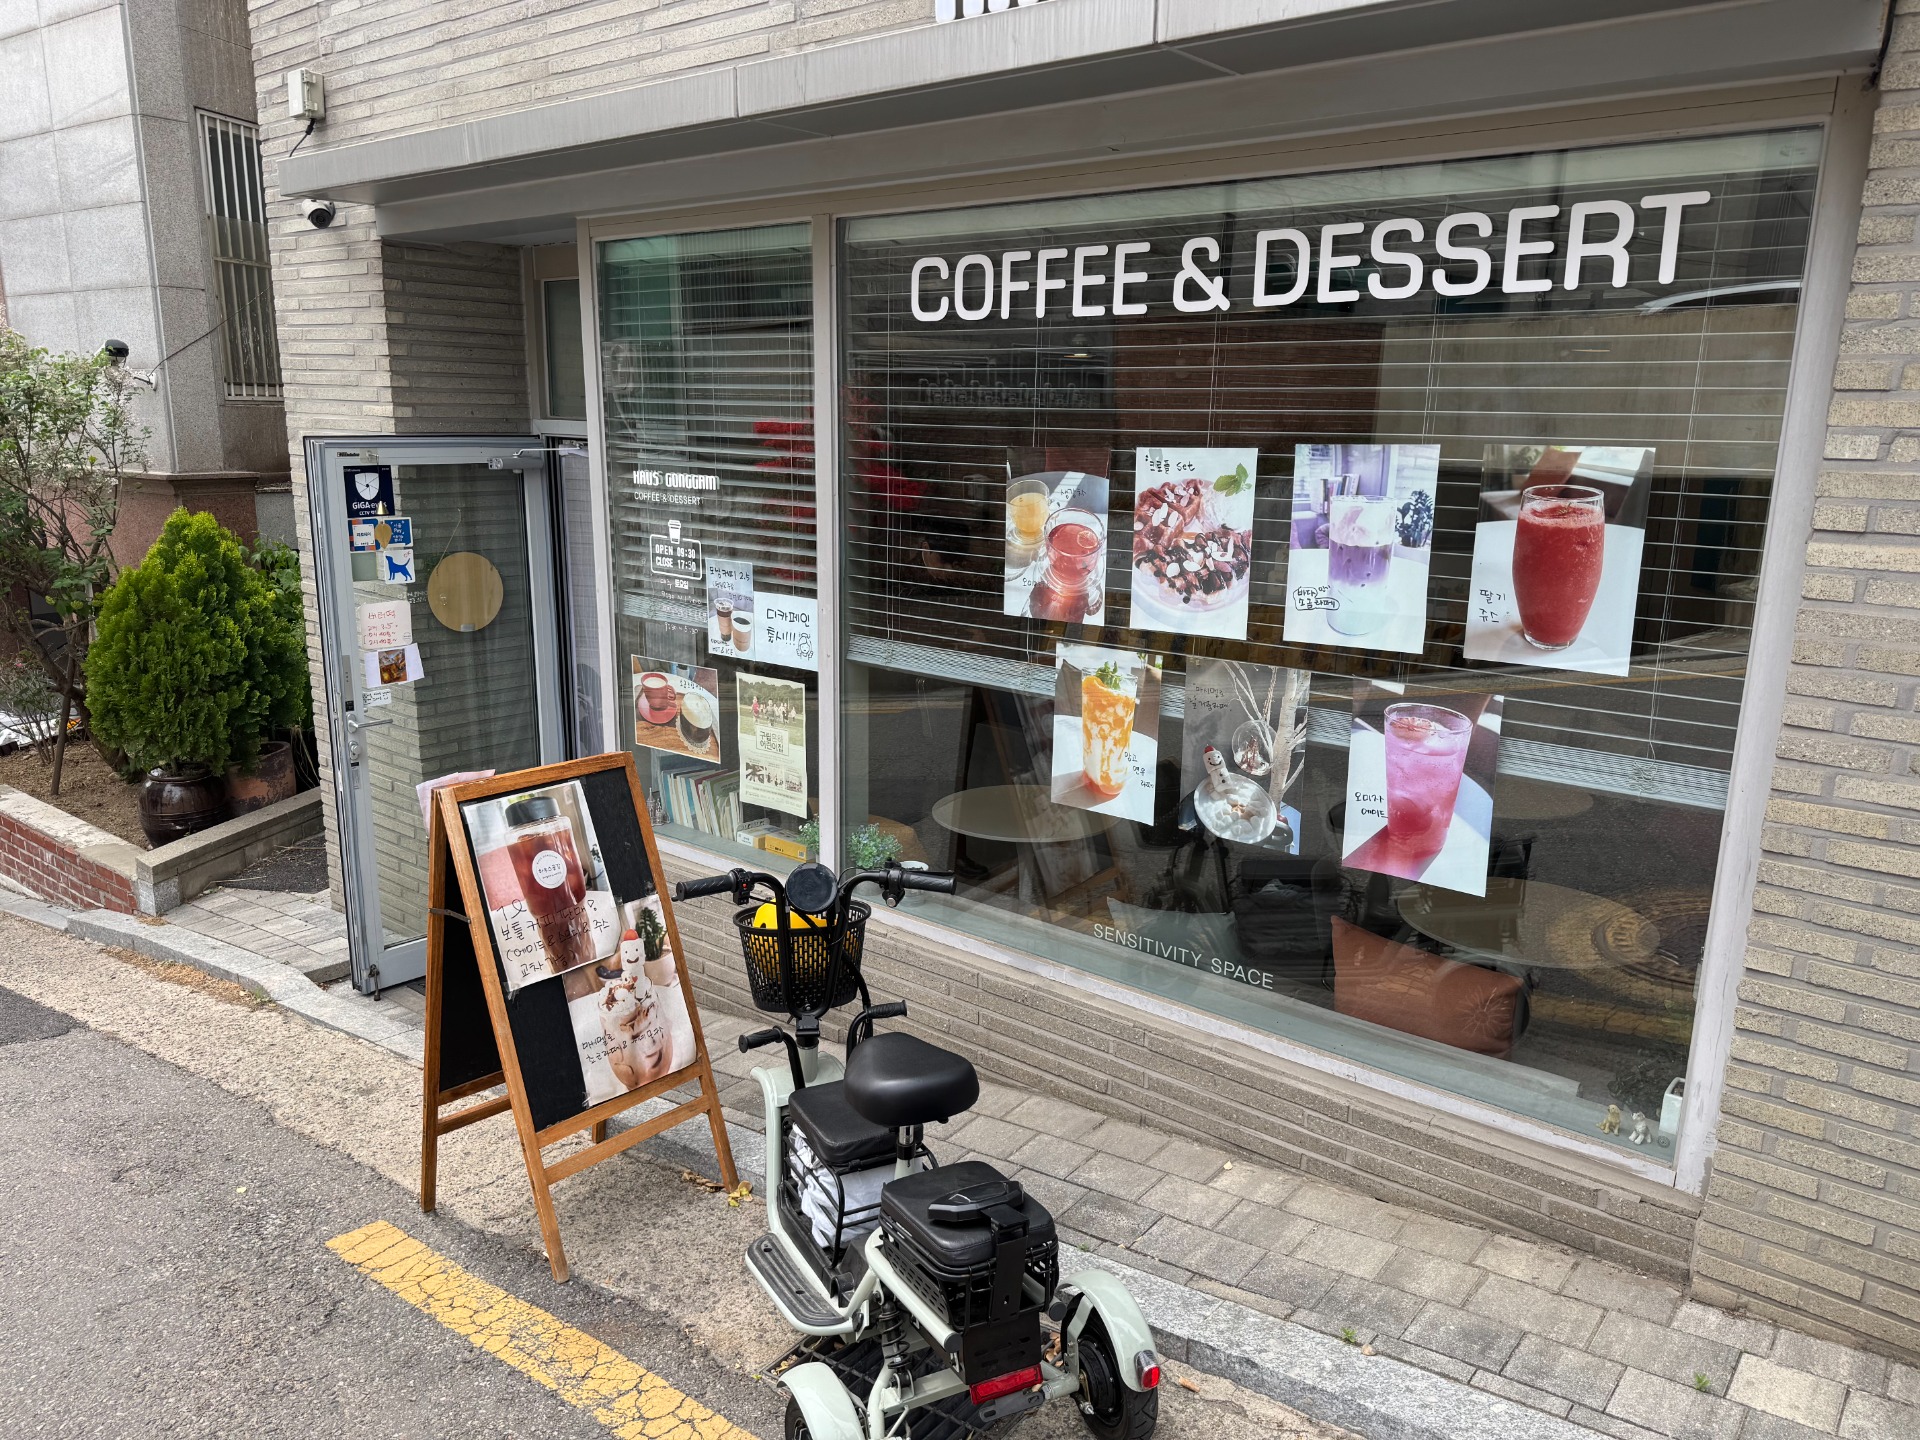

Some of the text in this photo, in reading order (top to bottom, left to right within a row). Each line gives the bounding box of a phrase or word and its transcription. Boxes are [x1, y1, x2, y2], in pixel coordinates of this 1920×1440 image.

[910, 190, 1711, 322] COFFEE & DESSERT
[632, 470, 660, 486] HAUS
[634, 491, 661, 502] COFFEE
[669, 494, 701, 506] DESSERT
[655, 544, 696, 559] OPEN 09:30
[655, 556, 697, 572] CLOSE 17:30
[1479, 589, 1506, 605] 딸기
[766, 608, 810, 628] 디카페인
[1478, 607, 1500, 623] 쥬스
[759, 740, 784, 753] 어린이집
[1354, 791, 1385, 803] 오미자
[501, 921, 525, 941] 보틀
[526, 913, 557, 932] 커피
[593, 918, 610, 933] 주스
[1093, 923, 1274, 990] SENSITIVITY SPACE
[520, 960, 544, 979] 교차
